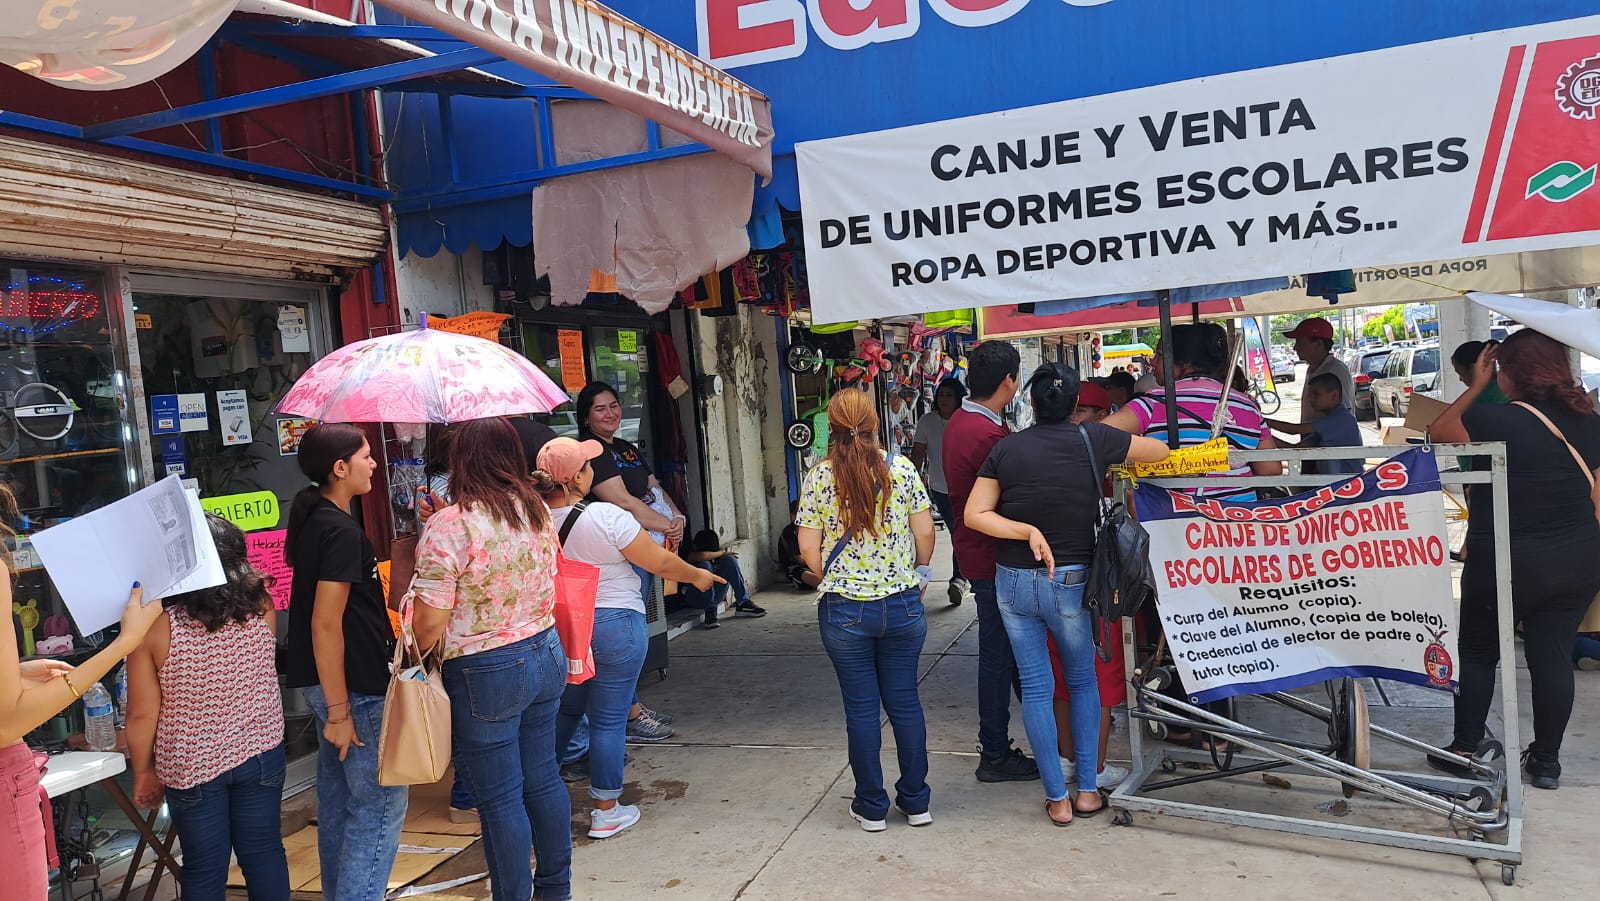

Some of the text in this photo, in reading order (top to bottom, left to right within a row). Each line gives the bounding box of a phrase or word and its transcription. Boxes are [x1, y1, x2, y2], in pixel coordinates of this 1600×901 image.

[550, 0, 762, 148] INDEPENDENCIA
[930, 97, 1316, 181] CANJE Y VENTA
[819, 137, 1469, 249] DE UNIFORMES ESCOLARES
[891, 201, 1398, 287] ROPA DEPORTIVA Y MÁS...
[0, 290, 100, 319] BIERTO
[180, 402, 204, 412] OPEN
[169, 465, 182, 473] VISA
[1152, 461, 1176, 471] vende
[1179, 457, 1202, 472] Agua
[1203, 456, 1229, 467] Natural
[1168, 477, 1365, 523] Edoardo
[1185, 501, 1409, 550] CANJE DE UNIFORME
[1164, 535, 1444, 589] ESCOLARES DE GOBIERNO
[1240, 574, 1357, 601] Requisitos:
[1173, 595, 1362, 628] Curp del Alumno (copia).
[1180, 609, 1448, 645] Clave del Alumno, (copia de boleta).
[1187, 627, 1424, 663] Credencial de elector de padre o
[1193, 657, 1280, 681] tutor (copia).
